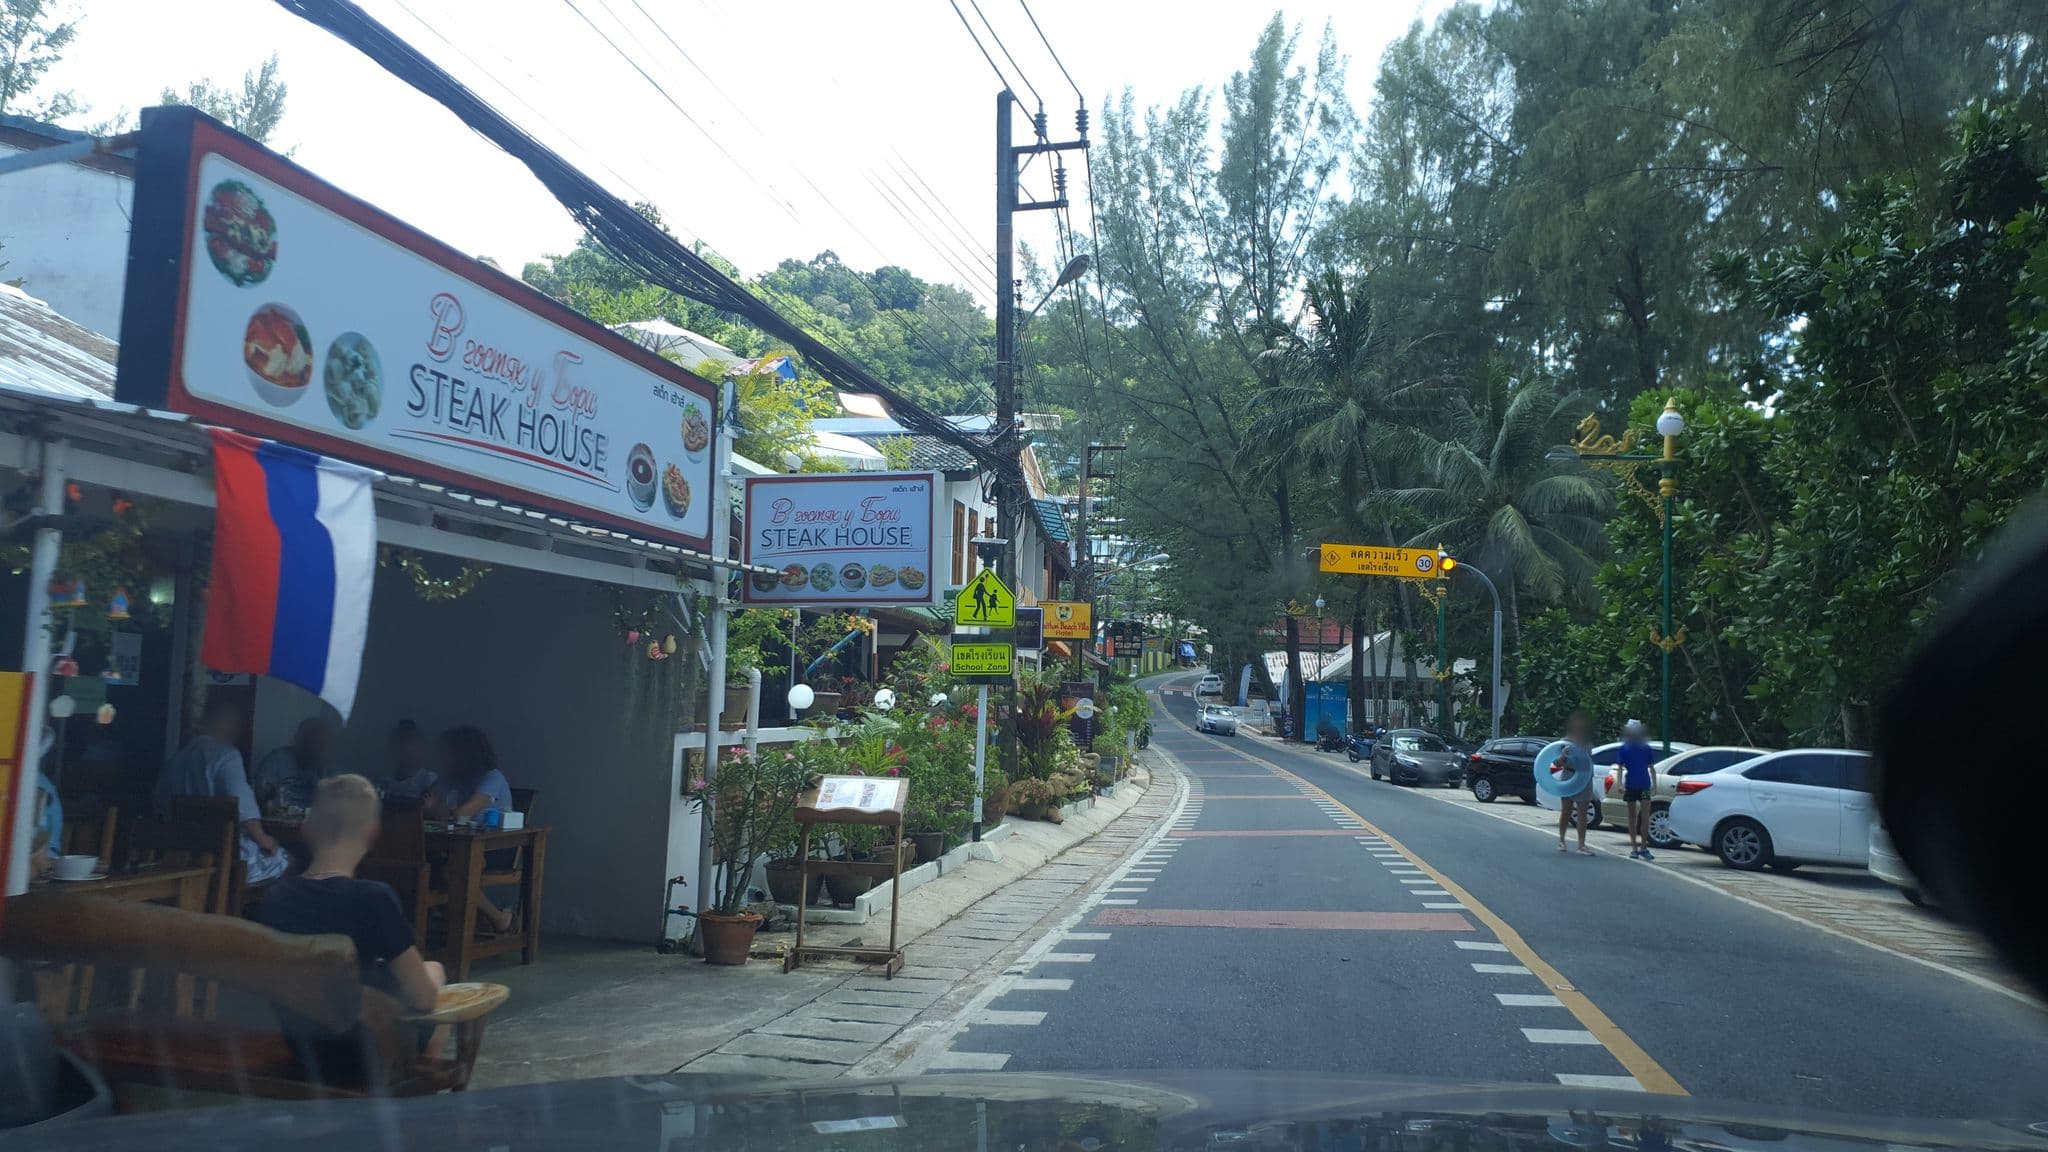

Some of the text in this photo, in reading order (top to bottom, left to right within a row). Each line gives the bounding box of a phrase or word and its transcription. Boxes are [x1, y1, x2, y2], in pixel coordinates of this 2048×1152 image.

[427, 292, 598, 426] В гостях у Бори
[407, 363, 607, 473] STEAK HOUSE
[771, 496, 899, 529] В гостях у Бори
[761, 527, 911, 547] STEAK HOUSE
[1350, 549, 1408, 561] ลดความเร็ว
[1358, 561, 1399, 572] เขตโรงเรียน
[1418, 558, 1431, 568] 30
[956, 648, 1006, 660] เขตโรงเรียน
[955, 663, 1008, 671] School Zone
